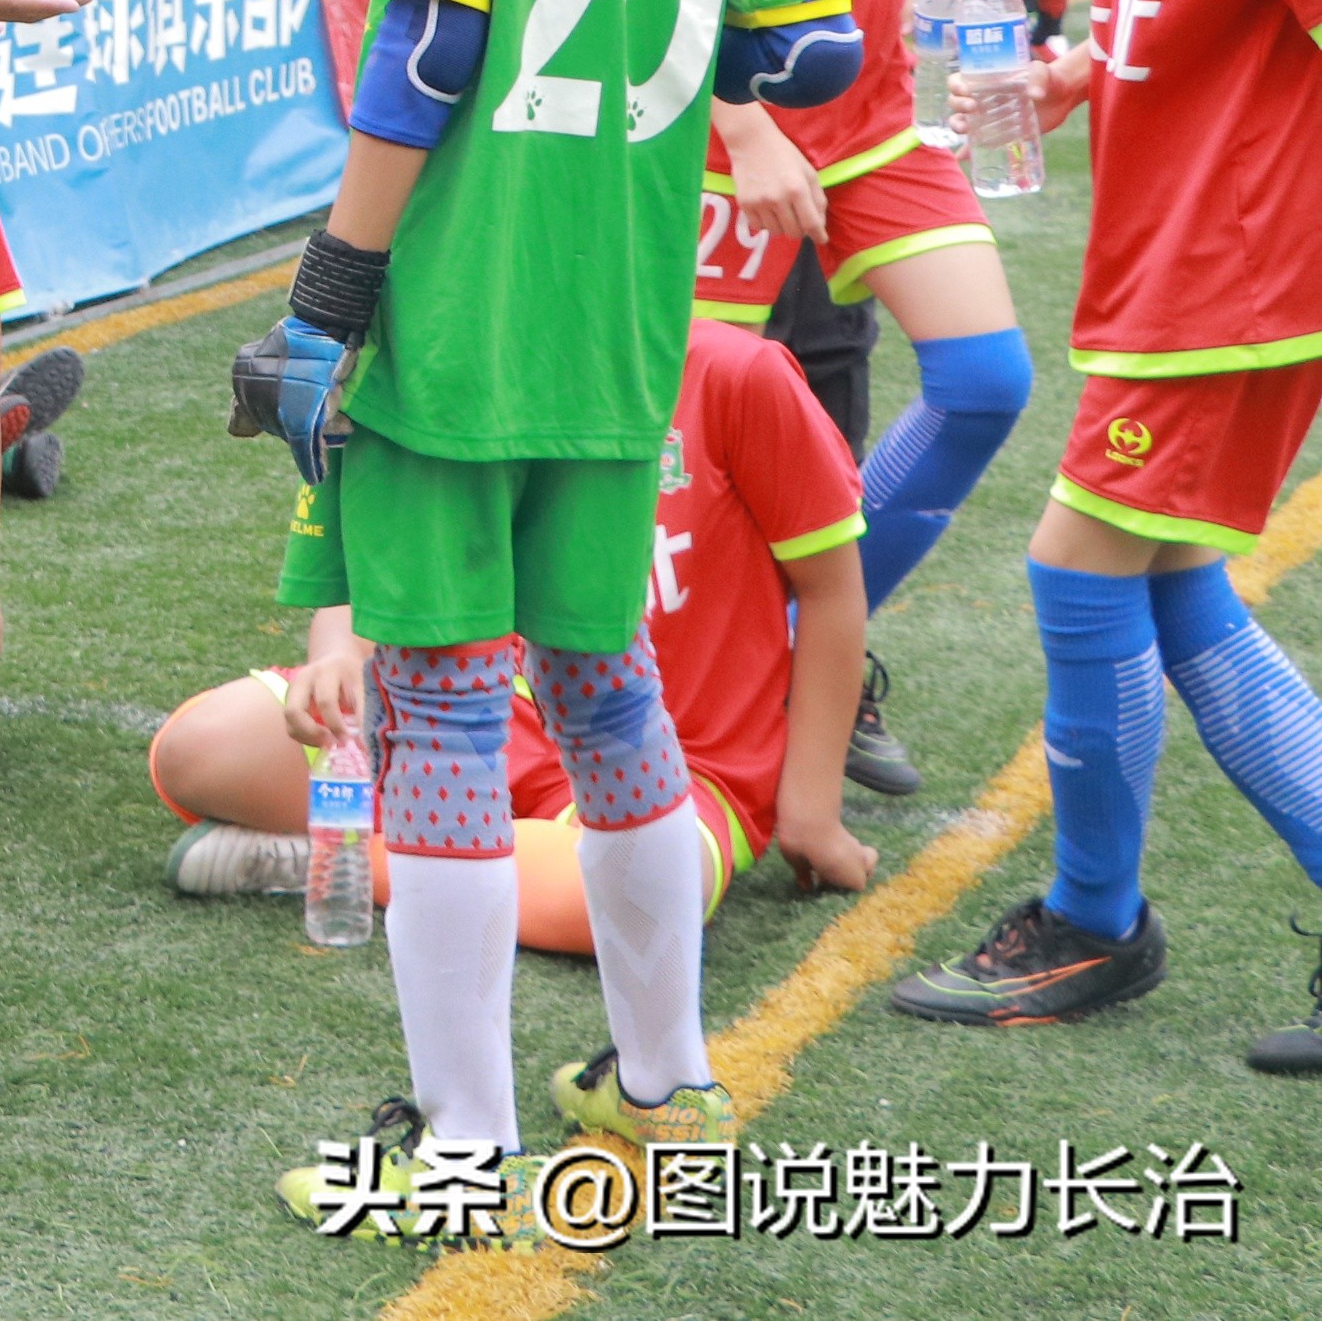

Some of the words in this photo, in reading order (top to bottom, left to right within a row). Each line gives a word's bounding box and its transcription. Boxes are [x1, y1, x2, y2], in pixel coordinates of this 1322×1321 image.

[248, 58, 317, 105] CLUB
[697, 191, 770, 280] 29
[290, 520, 325, 536] ELME
